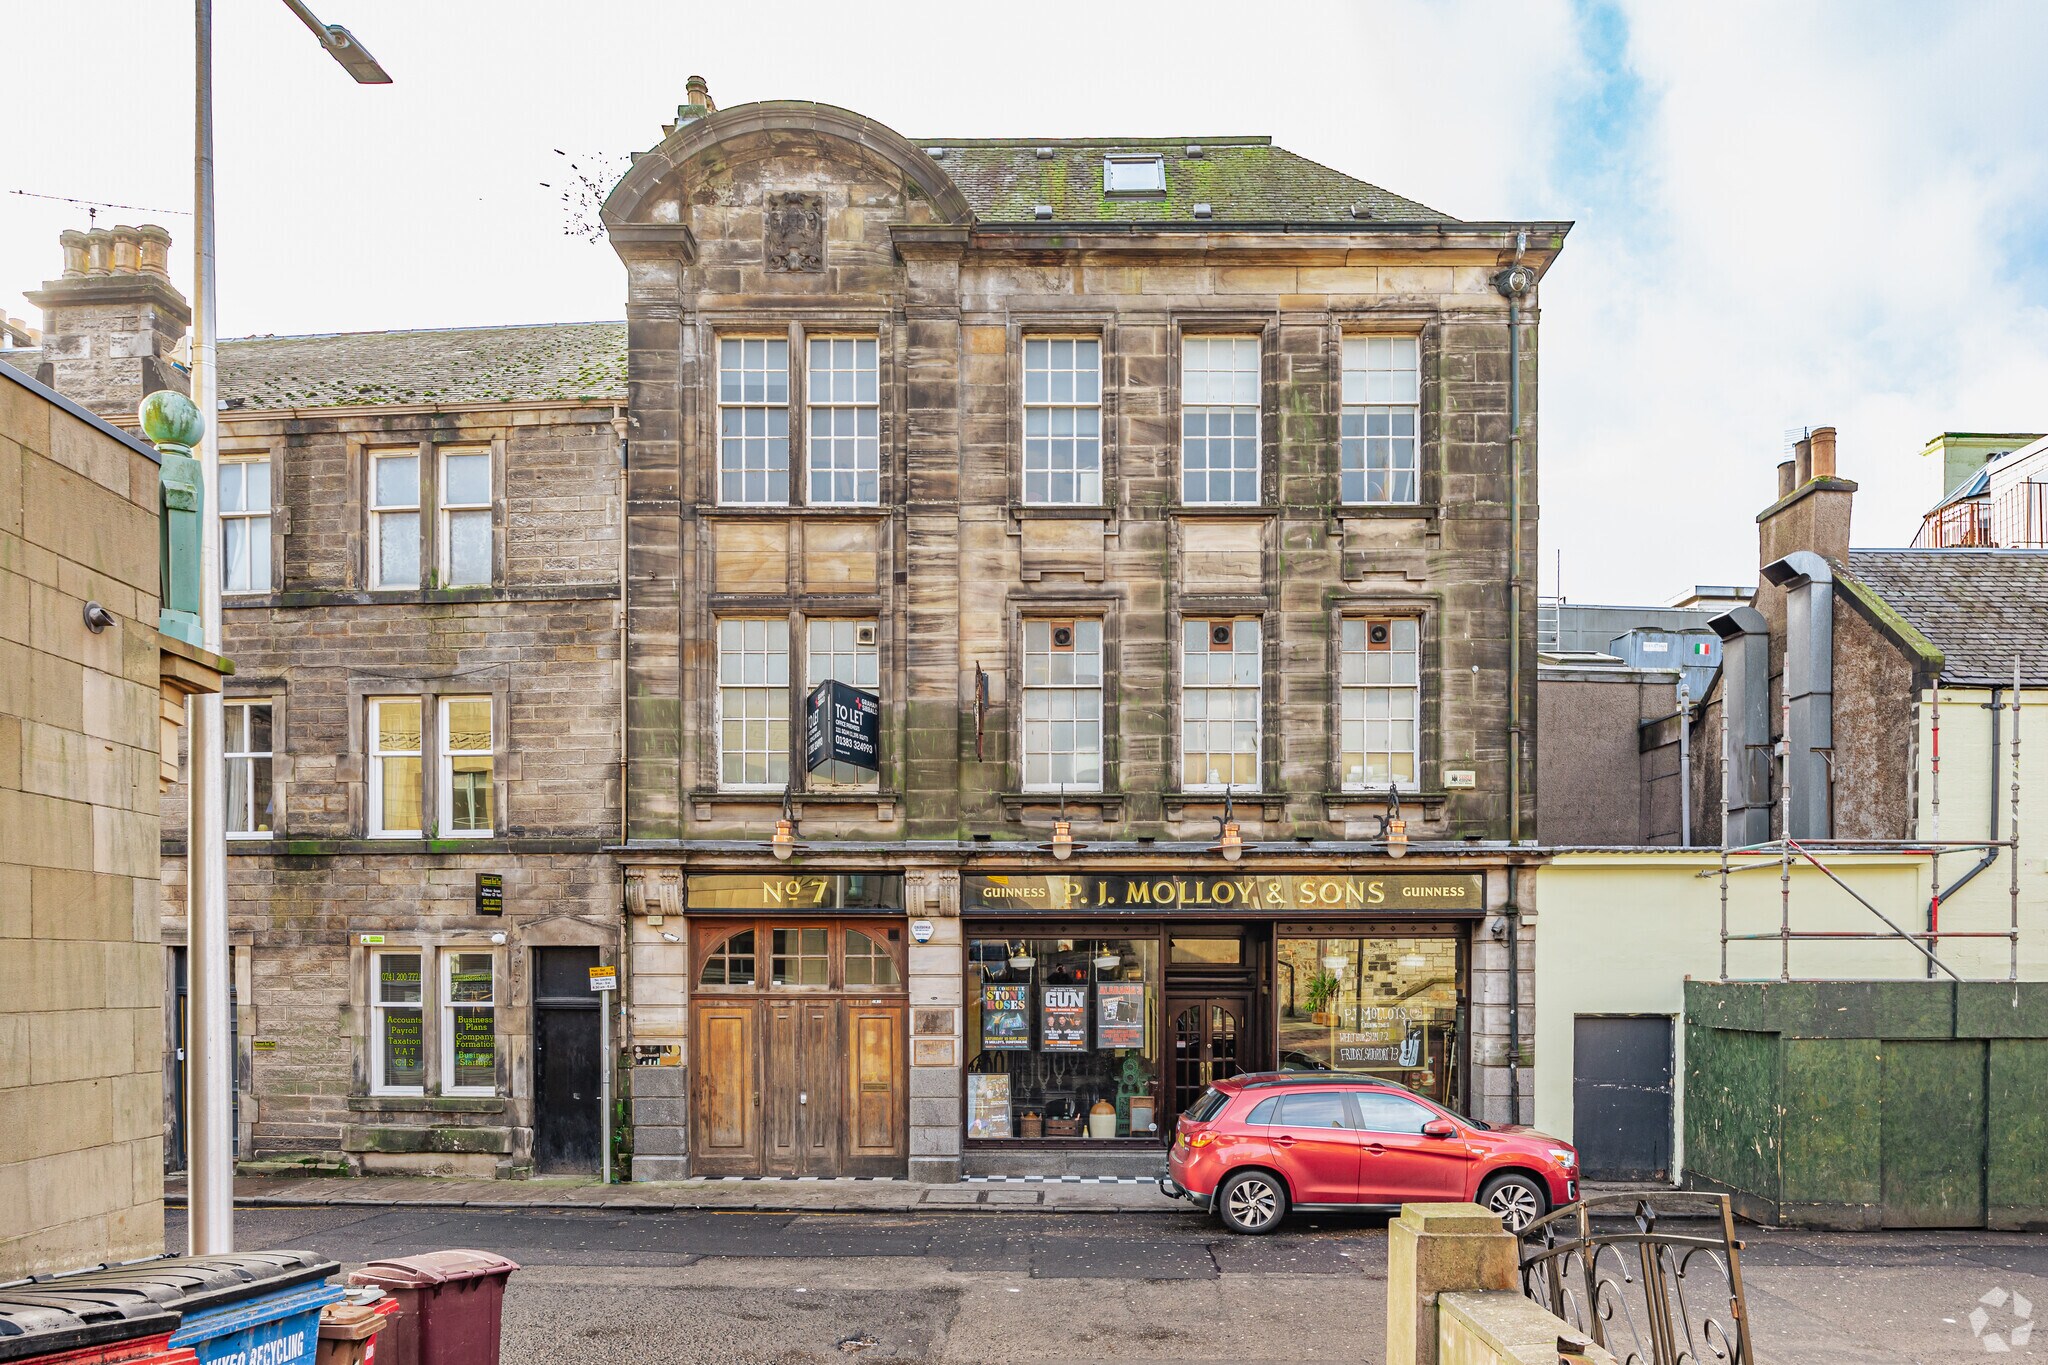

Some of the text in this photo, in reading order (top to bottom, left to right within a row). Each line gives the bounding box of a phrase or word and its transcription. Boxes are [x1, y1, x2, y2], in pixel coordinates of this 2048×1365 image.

[834, 702, 864, 726] TO LET
[835, 734, 853, 748] 01383
[853, 740, 873, 754] 324993
[810, 881, 828, 903] 7
[983, 887, 1046, 898] GUINNESS
[1064, 881, 1385, 906] P. J. MOLLOY & SONS
[1402, 886, 1465, 898] GUINNESS
[381, 972, 395, 981] 0741
[396, 972, 407, 981] 200
[986, 990, 1025, 1000] STONE
[1045, 991, 1085, 1008] GUN
[986, 1000, 1026, 1010] ROSES
[387, 1015, 423, 1024] Accounts
[457, 1015, 494, 1024] Business
[391, 1026, 418, 1036] Payroll
[465, 1023, 488, 1031] Plans
[387, 1036, 421, 1045] Taxation
[455, 1032, 495, 1042] Company
[455, 1040, 496, 1048] Formation
[458, 1050, 494, 1059] Business
[459, 1058, 493, 1068] Startups
[249, 1331, 304, 1365] RECYCLING
